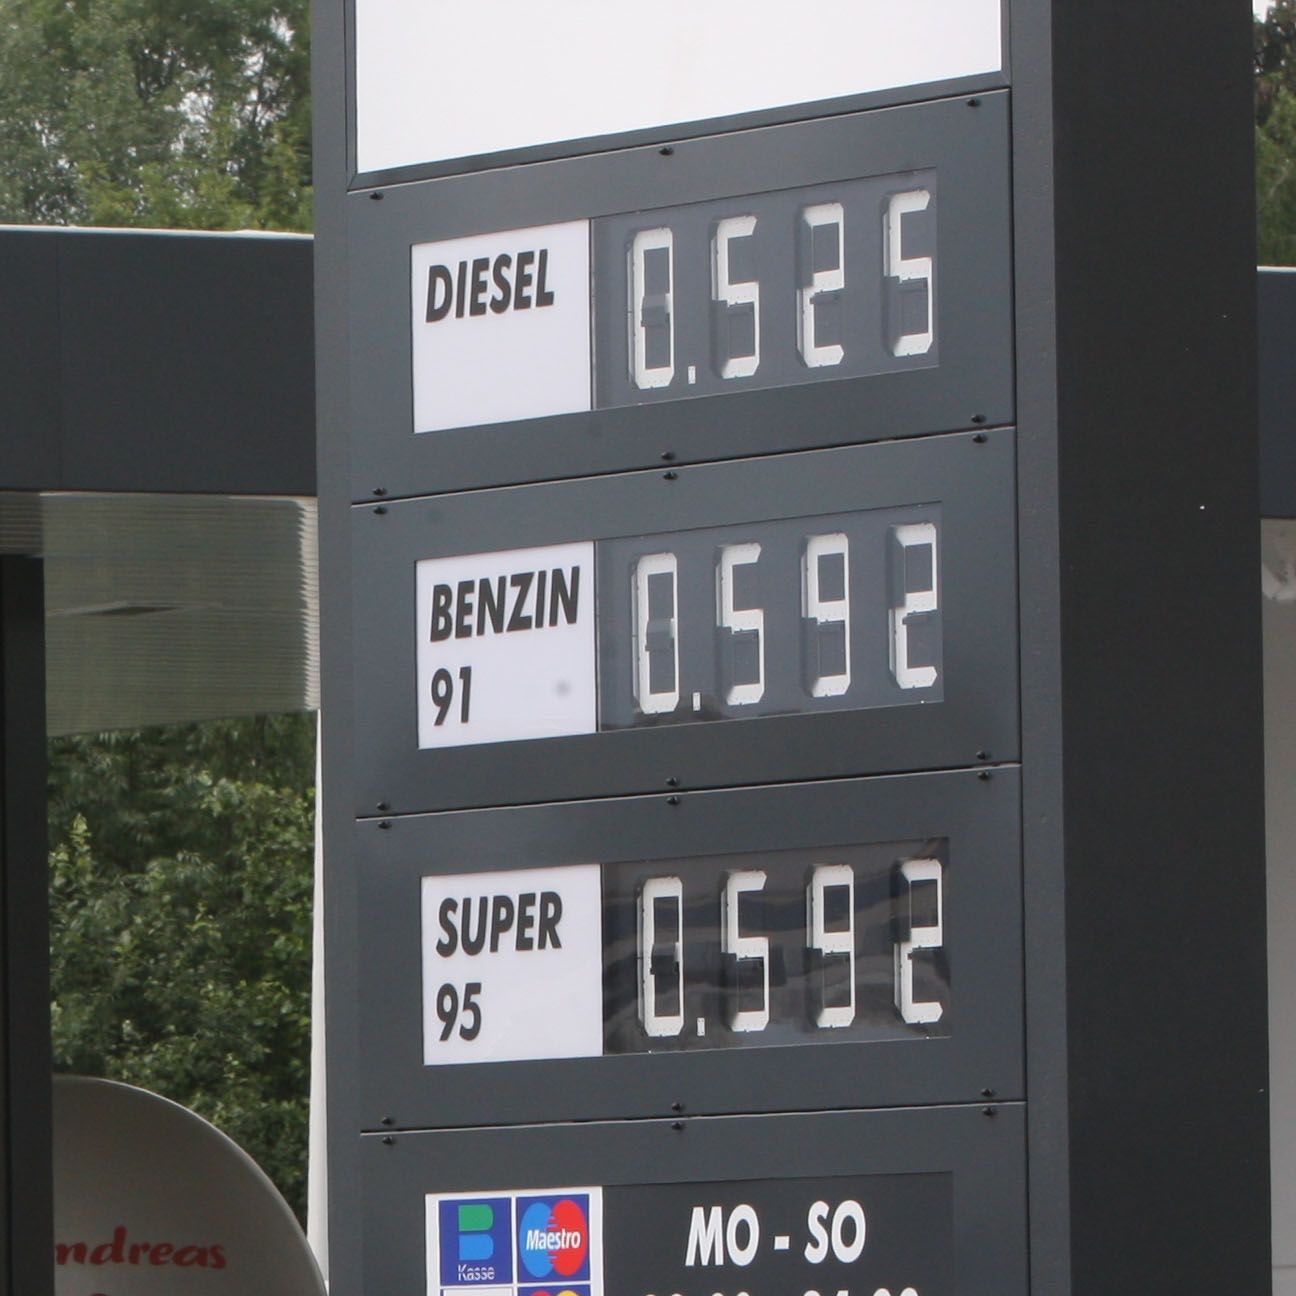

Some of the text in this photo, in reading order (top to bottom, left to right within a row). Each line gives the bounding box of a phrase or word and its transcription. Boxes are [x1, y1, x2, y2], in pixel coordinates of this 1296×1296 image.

[425, 248, 555, 323] DIESEL
[630, 190, 934, 389] 0.525
[430, 565, 582, 643] BENZIN
[634, 522, 938, 714] 0.592
[430, 665, 473, 727] 91
[435, 891, 563, 959] SUPER
[639, 858, 943, 1037] 0.592
[435, 981, 482, 1042] 95
[55, 1225, 228, 1270] ndreas
[525, 1228, 581, 1251] Maestro
[685, 1204, 760, 1267] MO
[804, 1199, 867, 1265] SO
[458, 1264, 495, 1281] Kasse
